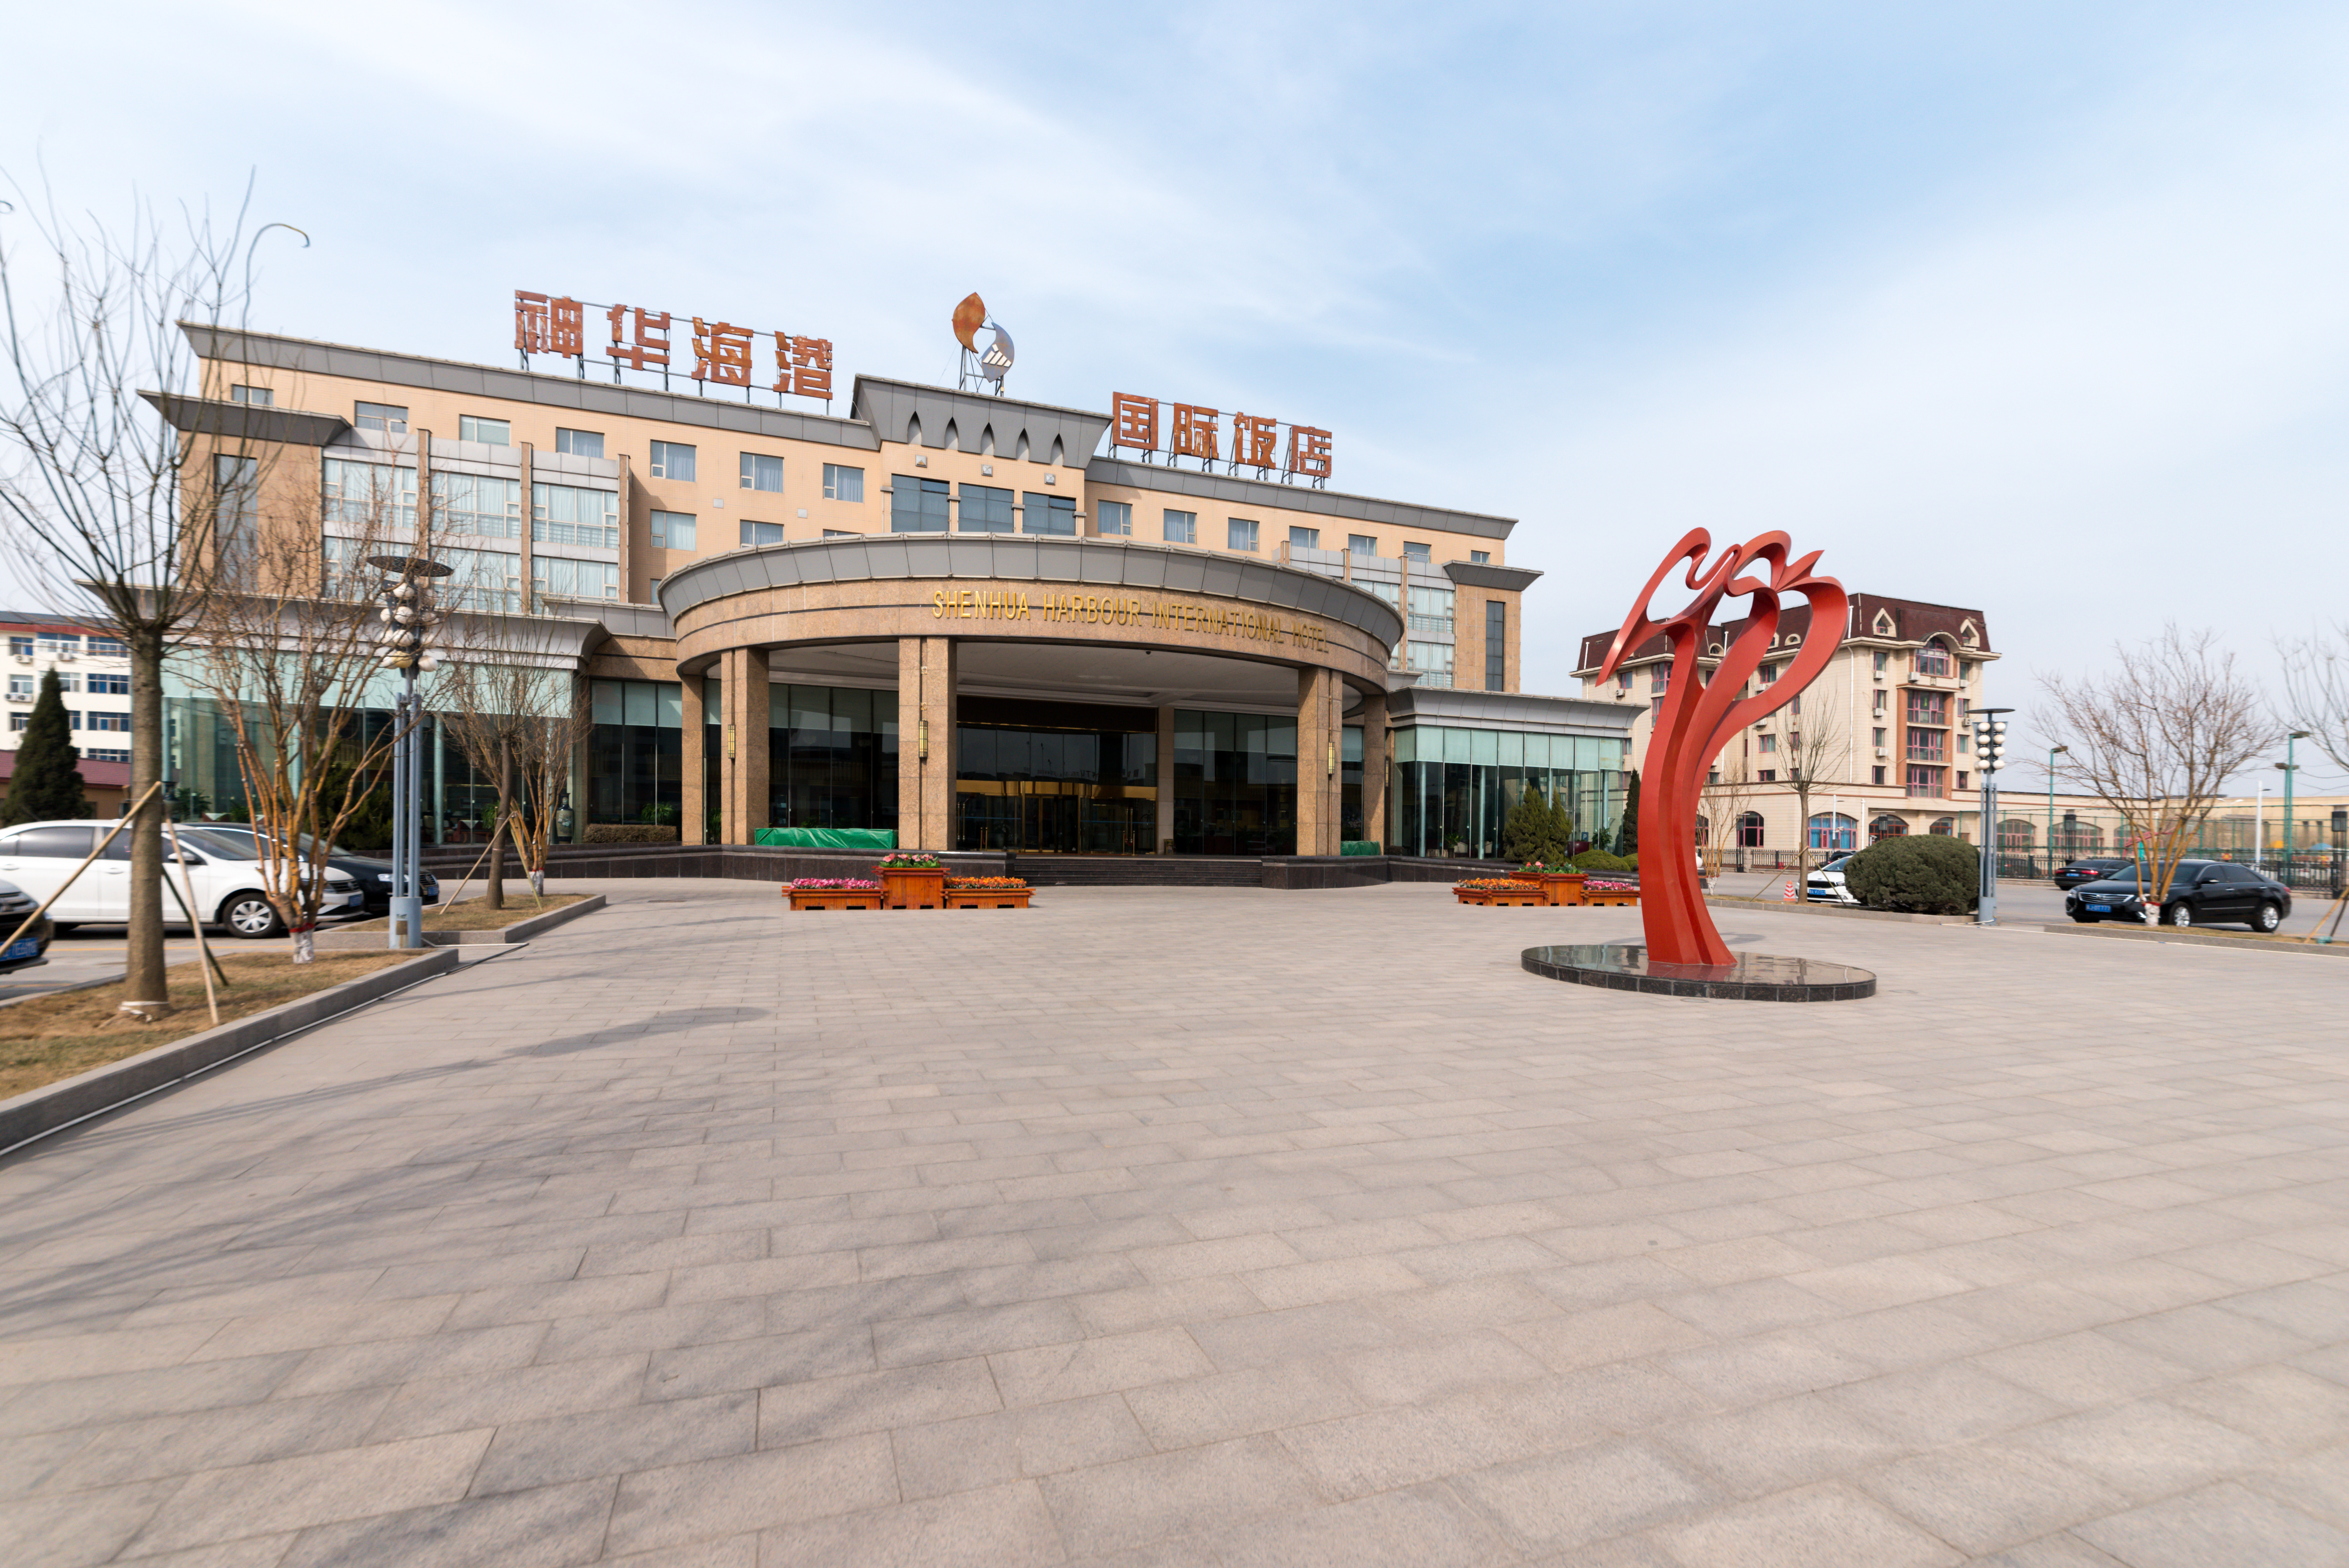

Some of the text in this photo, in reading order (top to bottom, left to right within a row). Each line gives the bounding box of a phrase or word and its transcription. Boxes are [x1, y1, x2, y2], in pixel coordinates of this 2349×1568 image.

[515, 289, 832, 400] 神华海港
[1112, 392, 1332, 478] 国际饭店
[932, 590, 1329, 653] SHENHUA HARBOUR INTERNATIONAL HOTEL
